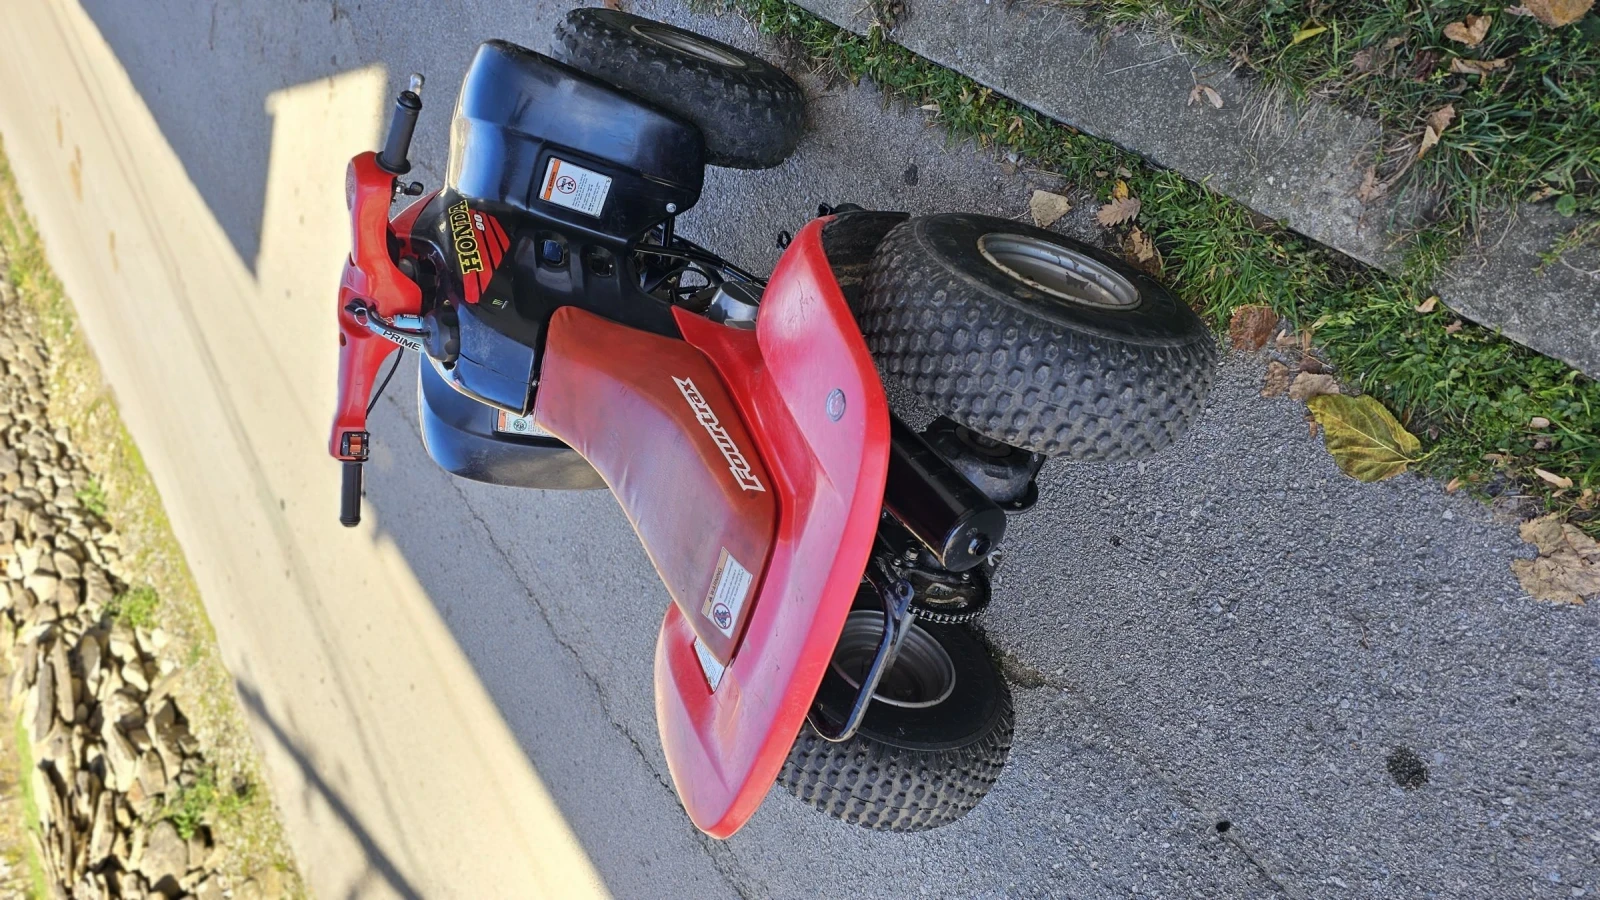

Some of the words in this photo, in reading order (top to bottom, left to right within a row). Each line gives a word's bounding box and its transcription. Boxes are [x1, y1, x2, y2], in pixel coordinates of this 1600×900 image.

[449, 199, 484, 274] HONDA
[474, 213, 485, 231] 90
[382, 329, 421, 351] PRIME
[672, 376, 766, 491] Fourtrax
